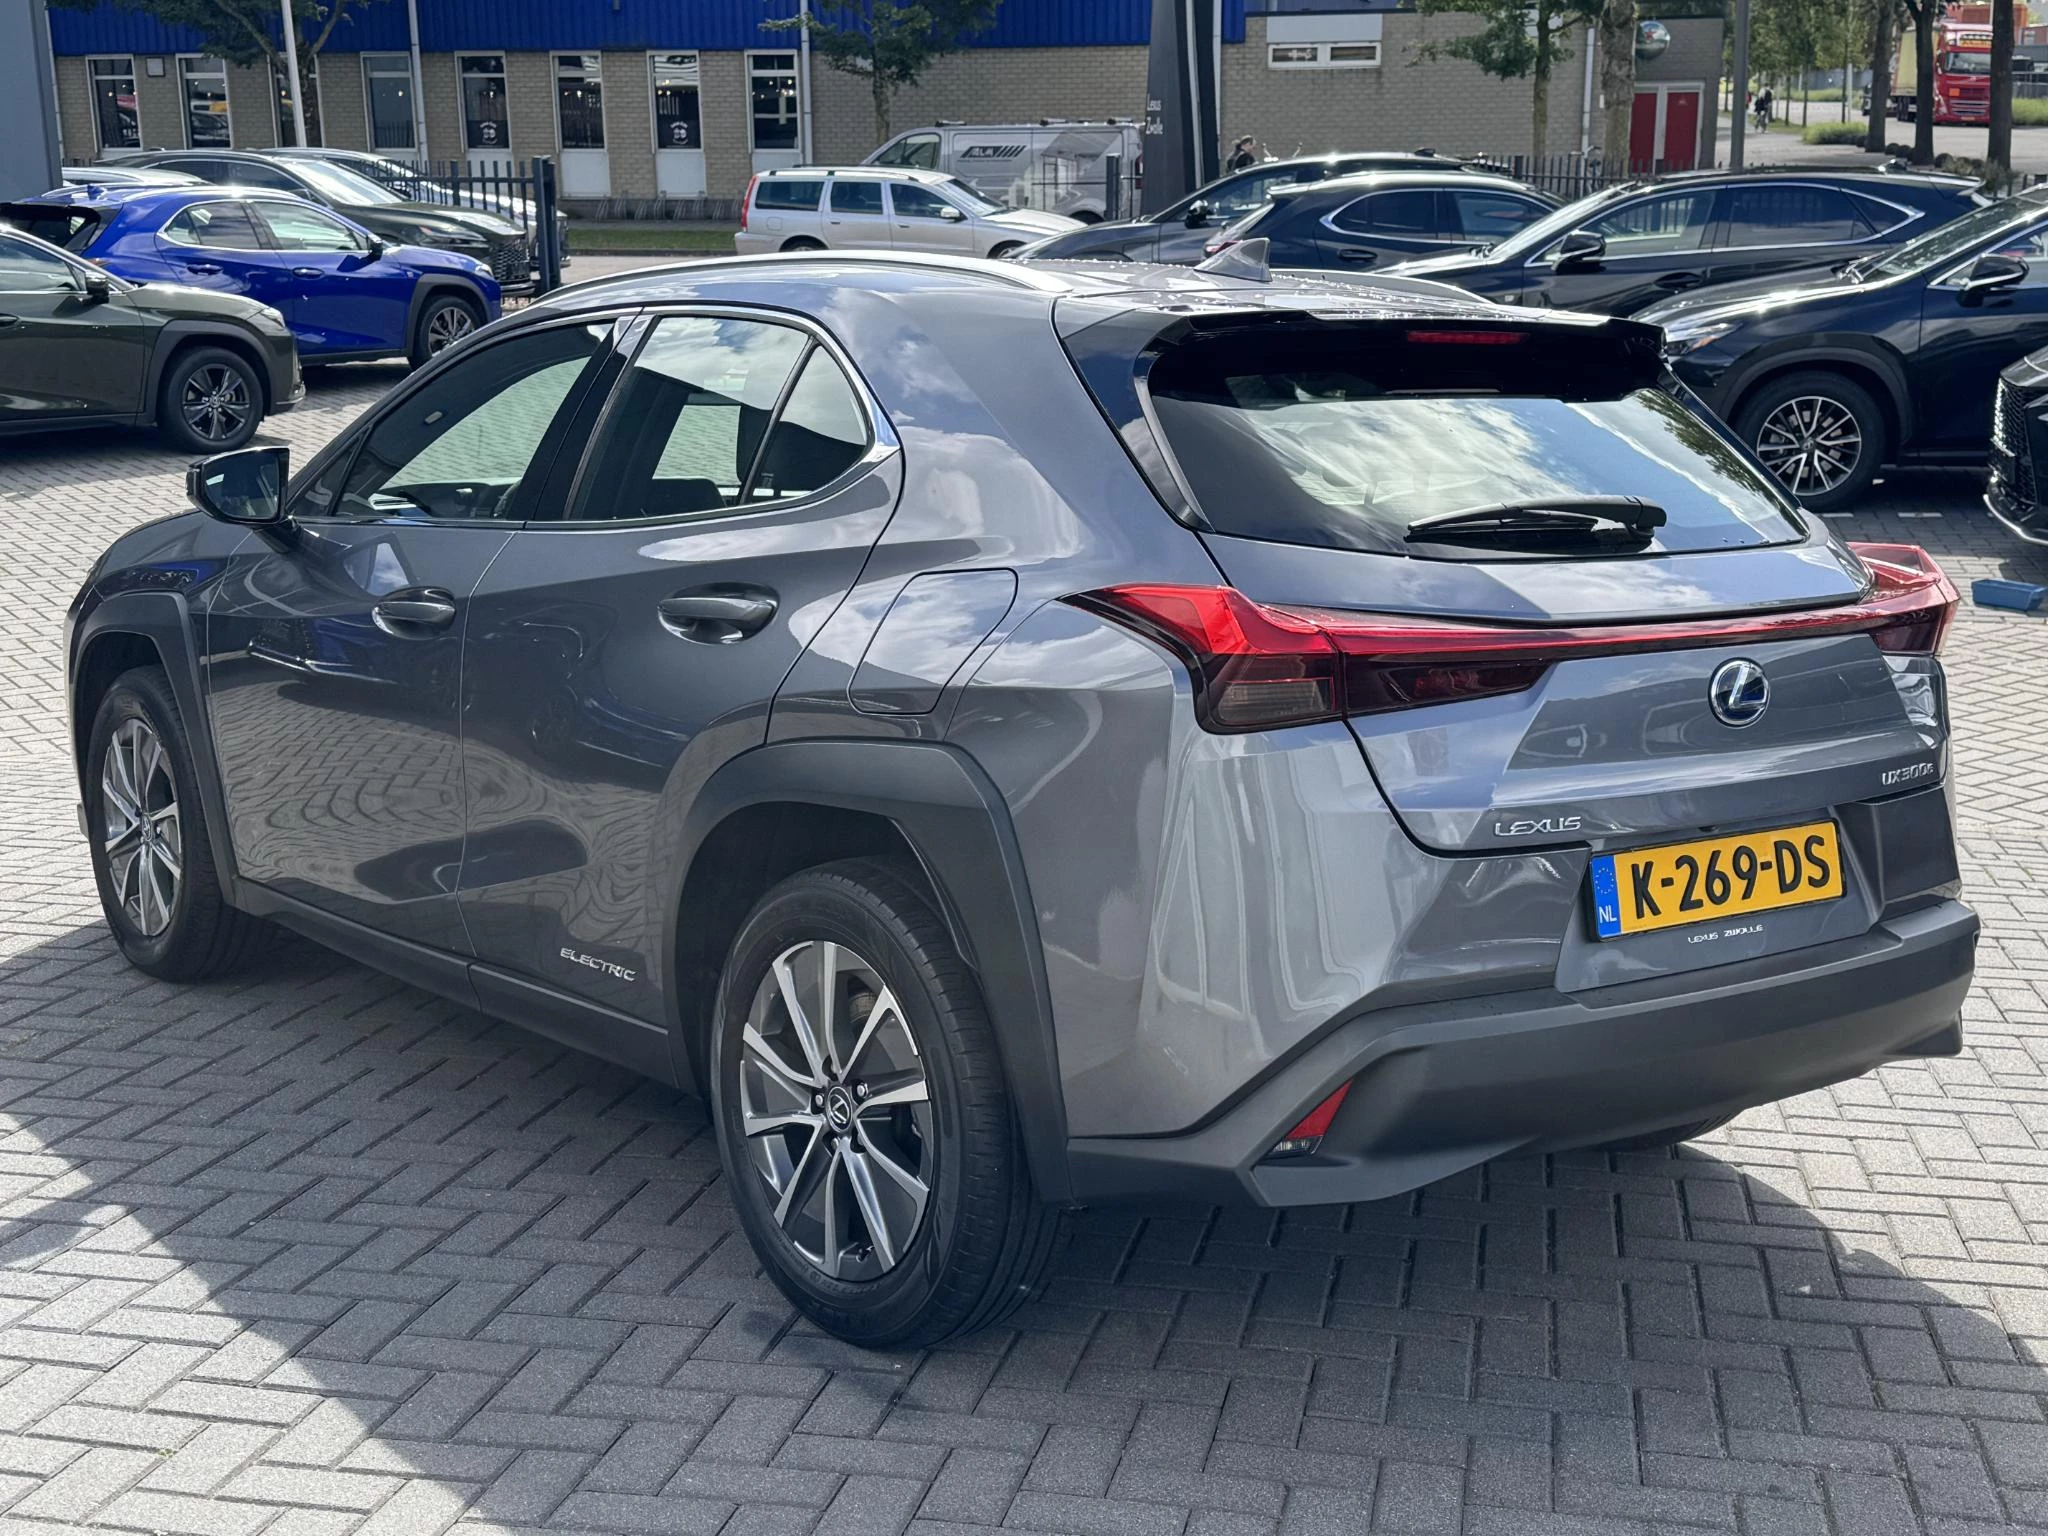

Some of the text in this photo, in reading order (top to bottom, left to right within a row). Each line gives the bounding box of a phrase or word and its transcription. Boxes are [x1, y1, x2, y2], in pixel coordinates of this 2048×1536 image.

[1494, 816, 1582, 837] LEXUS
[1631, 835, 1831, 919] K-269-DS
[1598, 905, 1617, 923] NL
[1687, 924, 1764, 944] LEXUS ZWOLLE
[560, 947, 636, 982] ELECTRIC
